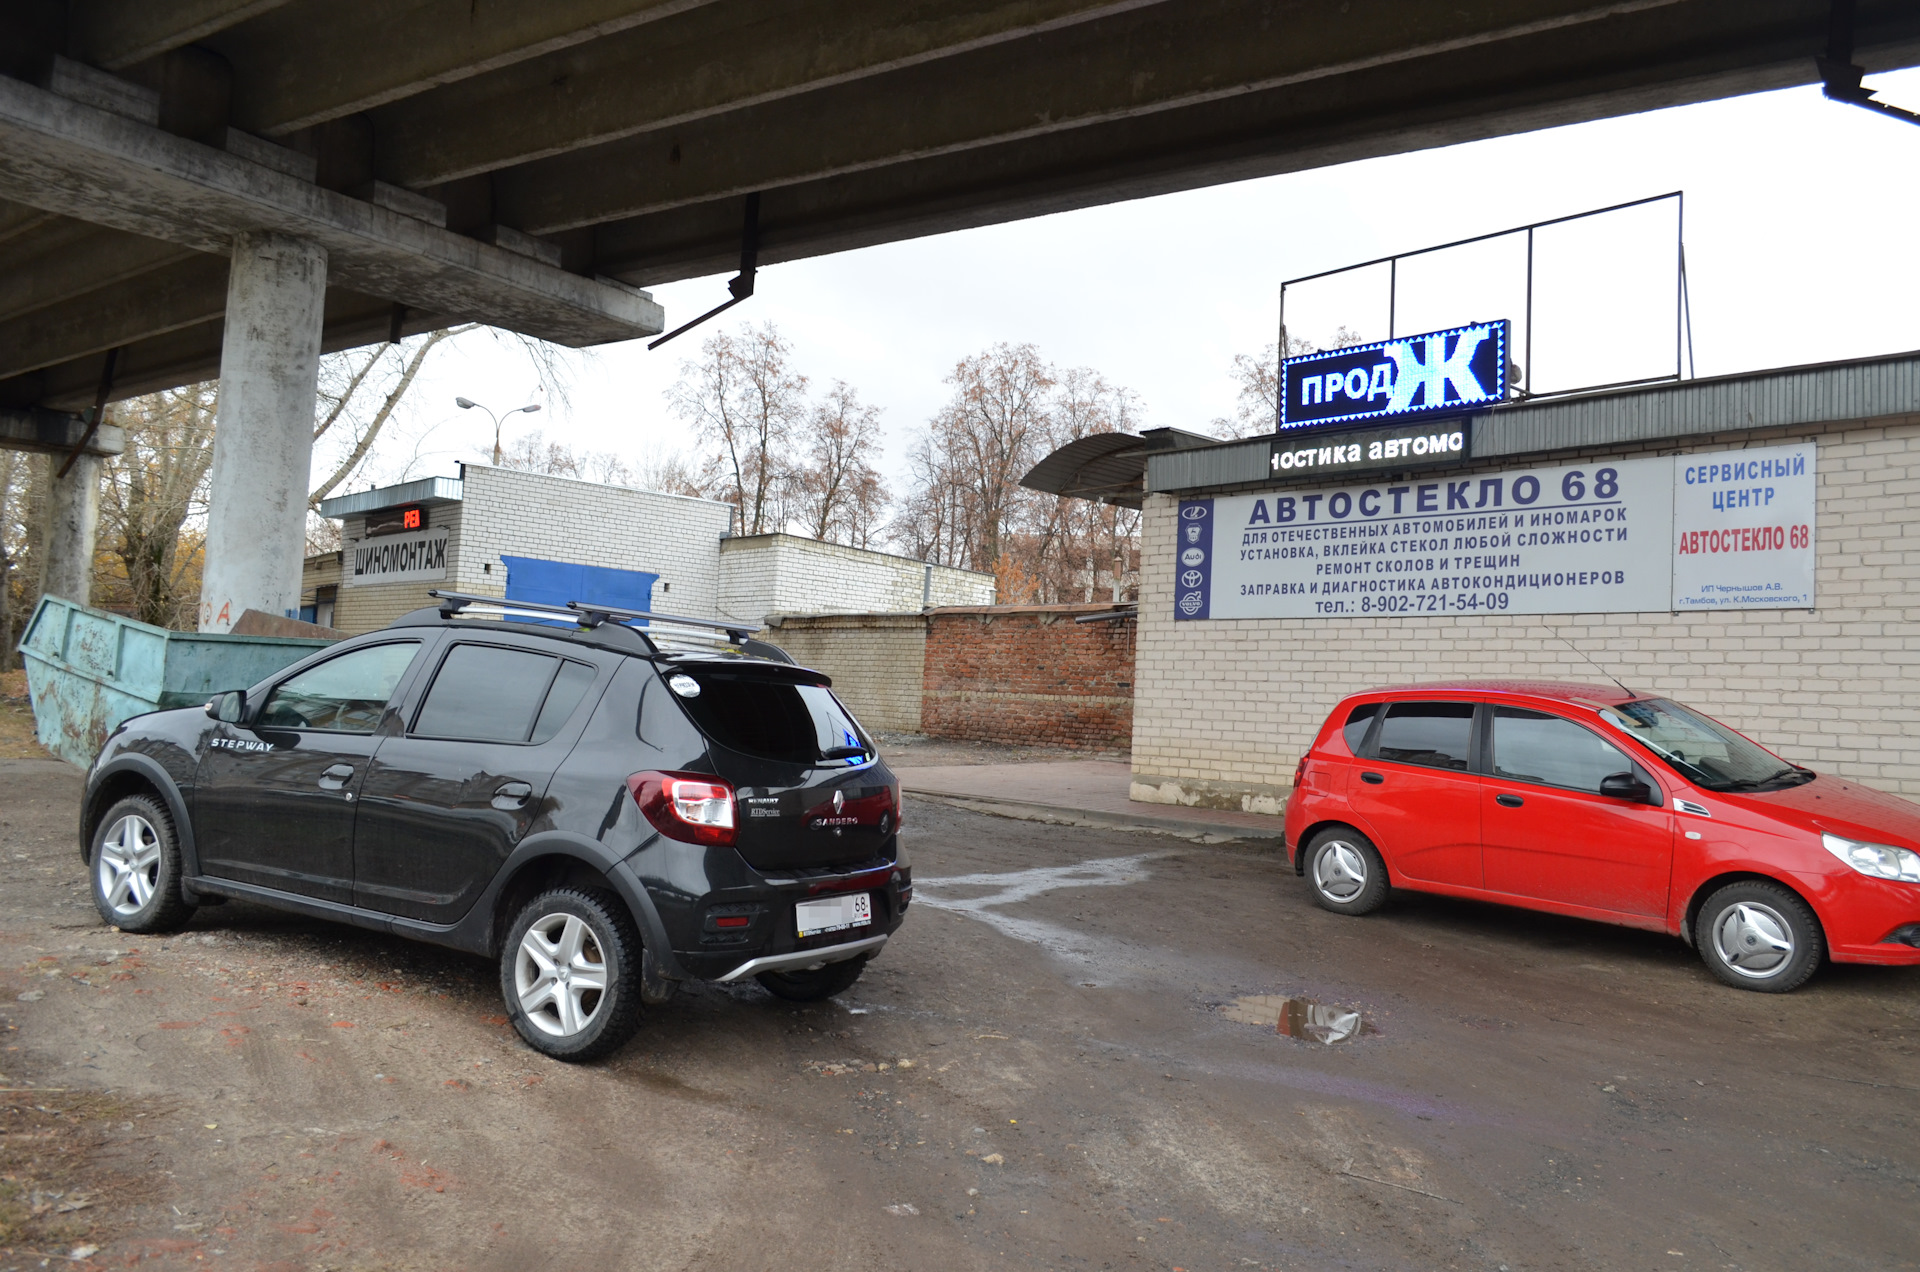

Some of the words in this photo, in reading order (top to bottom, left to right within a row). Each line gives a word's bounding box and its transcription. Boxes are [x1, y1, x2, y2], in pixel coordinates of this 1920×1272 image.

[1369, 432, 1463, 459] автомо
[1685, 453, 1806, 485] СЕРВИСНЫЙ
[1248, 475, 1541, 525] АВТОСТЕКЛО
[1561, 467, 1620, 502] 68
[1712, 487, 1775, 513] ЦЕНТР
[1241, 533, 1268, 547] ДЛЯ
[1271, 524, 1389, 543] ОТЕЧЕСТВЕННЫХ
[1392, 510, 1509, 536] АВТОМОБИЛЕЙ
[1514, 514, 1524, 528] И
[1530, 507, 1628, 527] ИНОМАРОК
[1679, 526, 1785, 555] АВТОСТЕКЛО
[1789, 524, 1809, 550] 68
[355, 538, 447, 576] ШИНОМОНТАЖ
[1240, 547, 1319, 562] УСТАНОВКА,
[1323, 540, 1386, 557] ВКЛЕЙКА
[1390, 538, 1449, 554] СТЕКОЛ
[1452, 531, 1512, 551] ЛЮБОЙ
[1517, 527, 1628, 547] СЛОЖНОСТИ
[1316, 562, 1372, 576] РЕМОНТ
[1376, 557, 1434, 573] СКОЛОВ
[1439, 557, 1449, 570] И
[1454, 553, 1520, 570] ТРЕЩИН
[1240, 583, 1305, 596] ЗАПРАВКА
[1309, 582, 1318, 594] И
[1322, 578, 1426, 596] ДИАГНОСТИКА
[1431, 570, 1625, 590] АВТОКОНДИЦИОНЕРОВ
[1701, 585, 1714, 593] ИП
[1716, 584, 1763, 594] Чернышов
[1765, 583, 1783, 591] А.В.
[1315, 599, 1355, 613] тел.:
[1361, 592, 1509, 613] 8-902-721-54-09
[211, 738, 274, 752] STEPWAY
[816, 817, 858, 826] SANDERO
[854, 896, 866, 912] 68
